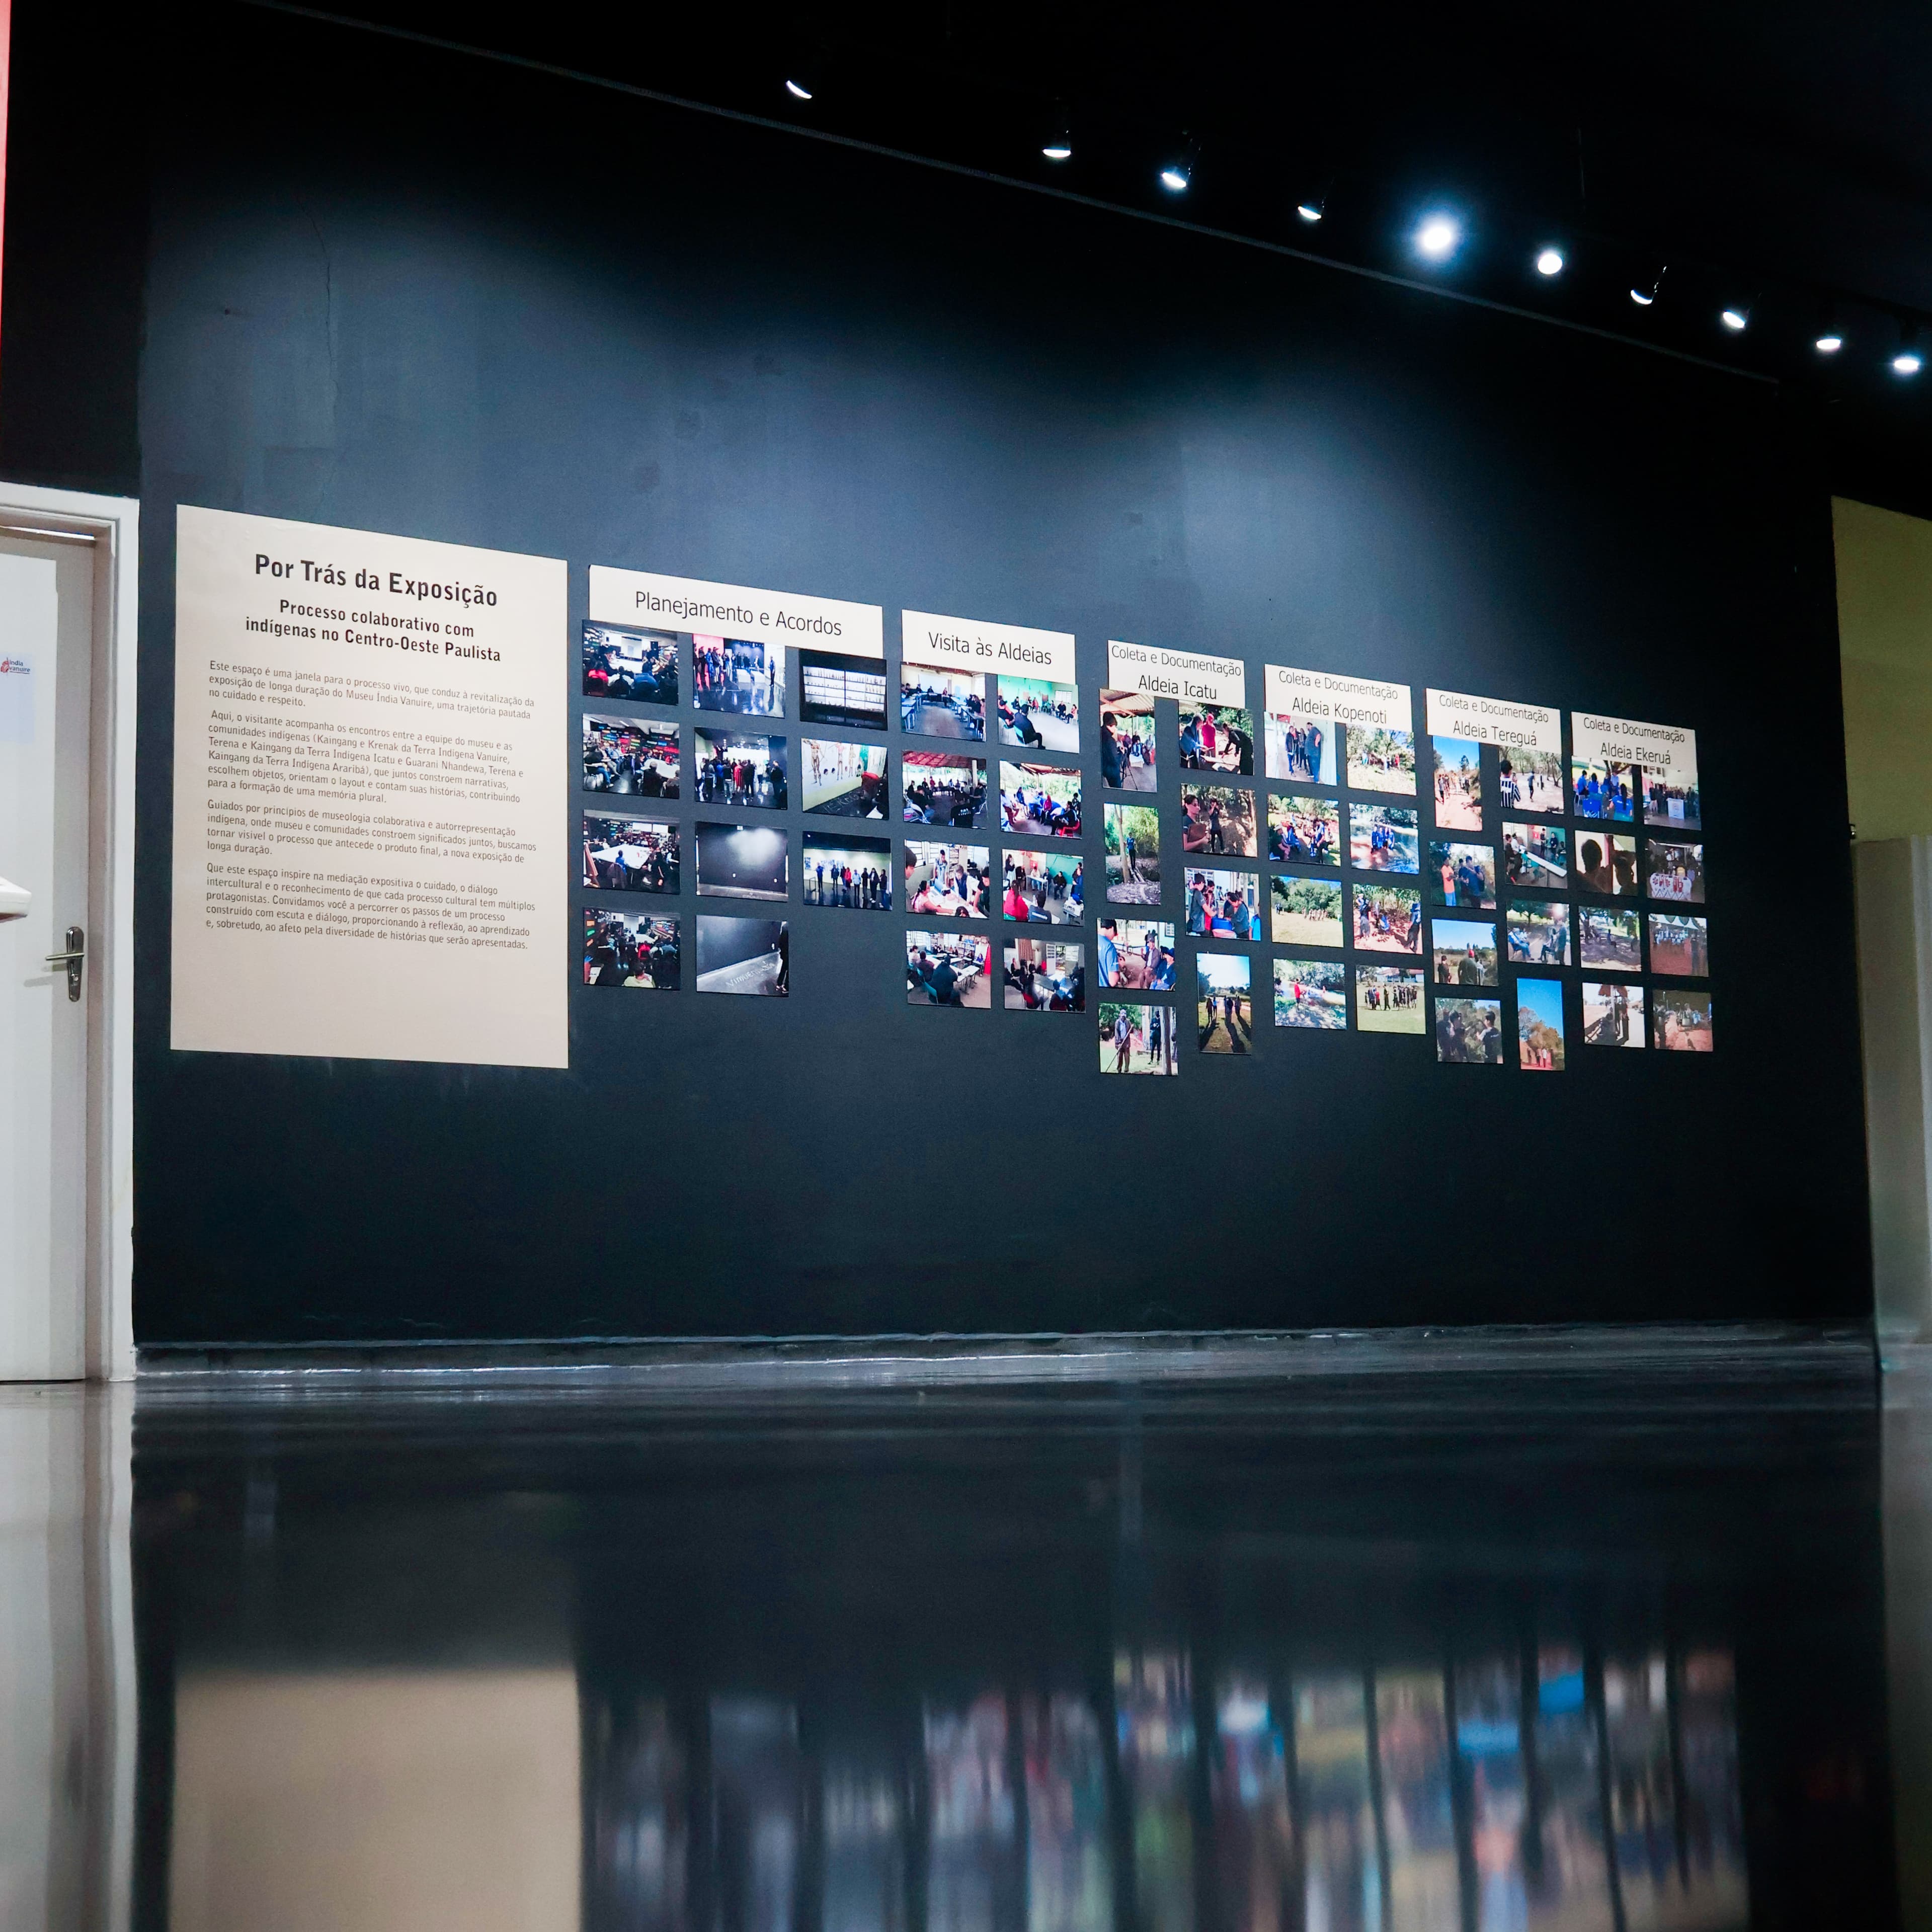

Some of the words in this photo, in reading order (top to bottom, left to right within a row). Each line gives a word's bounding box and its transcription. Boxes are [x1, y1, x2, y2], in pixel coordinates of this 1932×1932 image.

[256, 553, 294, 578] Por
[300, 559, 346, 586] Trás
[355, 569, 380, 591] da
[389, 572, 497, 608] Exposição
[280, 599, 346, 620] Processo
[351, 611, 439, 632] colaborativo
[445, 624, 473, 637] com
[636, 591, 753, 623] Planejamento
[760, 613, 769, 625] e
[776, 611, 841, 635] Acordos
[246, 616, 316, 638] indígenas
[322, 629, 339, 641] no
[345, 629, 439, 654] Centro-Oeste
[445, 641, 501, 662] Paulista
[929, 632, 969, 653] Visita
[976, 637, 992, 656] às
[998, 642, 1052, 665] Aldeias
[1112, 646, 1146, 662] Coleta
[1151, 654, 1157, 663] e
[1162, 653, 1241, 677] Documentação
[209, 676, 253, 688] exposição
[255, 679, 266, 689] de
[269, 680, 292, 692] longa
[295, 684, 330, 697] duração
[332, 688, 343, 697] do
[346, 689, 373, 701] Museu
[376, 691, 397, 703] Índia
[437, 702, 454, 710] uma
[457, 703, 496, 715] trajetória
[499, 709, 530, 719] pautada
[210, 660, 229, 671] Este
[232, 665, 262, 677] espaço
[265, 667, 270, 676] é
[273, 670, 292, 678] uma
[294, 670, 321, 682] janela
[324, 676, 343, 684] para
[354, 679, 390, 690] processo
[393, 682, 412, 694] vivo,
[414, 686, 429, 695] que
[432, 688, 460, 698] conduz
[470, 692, 522, 706] revitalização
[525, 698, 534, 706] da
[222, 690, 257, 701] cuidado
[267, 696, 305, 706] respeito.
[1138, 675, 1178, 695] Aldeia
[1184, 681, 1217, 700] Icatu
[1279, 671, 1311, 686] Coleta
[1315, 679, 1320, 687] e
[1325, 678, 1397, 700] Documentação
[1293, 697, 1329, 715] Aldeia
[1334, 703, 1386, 725] Kopenoti
[1439, 695, 1468, 709] Coleta
[1472, 703, 1477, 711] e
[1481, 701, 1548, 723] Documentação
[211, 709, 234, 722] Aqui,
[245, 713, 283, 726] visitante
[285, 719, 334, 731] acompanha
[349, 727, 390, 738] encontros
[392, 731, 415, 740] entre
[425, 735, 452, 745] equipe
[455, 737, 465, 746] do
[467, 740, 494, 748] museu
[1453, 720, 1487, 738] Aldeia
[1491, 726, 1536, 748] Tereguá
[1584, 717, 1611, 732] Coleta
[1614, 725, 1619, 733] e
[1622, 723, 1684, 744] Documentação
[1600, 743, 1632, 760] Aldeia
[1636, 747, 1670, 765] Ekeruá
[207, 779, 228, 788] para
[239, 779, 280, 794] formação
[283, 784, 294, 794] de
[296, 787, 315, 796] uma
[318, 789, 356, 800] memória
[359, 792, 386, 803] plural.
[208, 765, 249, 776] escolhem
[252, 768, 286, 782] objetos,
[288, 772, 328, 784] orientam
[339, 776, 365, 788] layout
[375, 782, 407, 791] contam
[409, 785, 427, 793] suas
[430, 785, 467, 799] histórias,
[469, 791, 520, 802] contribuindo
[207, 799, 243, 812] Guiados
[246, 805, 261, 814] por
[308, 809, 319, 818] de
[322, 812, 370, 824] museologia
[373, 815, 425, 828] colaborativa
[435, 822, 515, 837] autorrepresentação
[207, 840, 231, 852] longa
[234, 842, 272, 856] duração.
[207, 862, 224, 873] Que
[226, 866, 246, 874] este
[248, 868, 278, 879] espaço
[281, 868, 310, 880] inspire
[327, 873, 368, 886] mediação
[370, 877, 413, 888] expositiva
[424, 881, 458, 893] cuidado,
[467, 883, 498, 896] diálogo
[207, 876, 262, 890] intercultural
[281, 883, 351, 896] reconhecimento
[353, 888, 364, 898] de
[366, 891, 382, 900] que
[384, 891, 404, 900] cada
[407, 894, 443, 904] processo
[445, 896, 476, 906] cultural
[479, 898, 495, 908] tem
[498, 900, 535, 911] múltiplos
[206, 892, 270, 904] protagonistas.
[272, 895, 325, 908] Convidamos
[327, 900, 347, 909] você
[357, 903, 398, 913] percorrer
[413, 907, 440, 917] passos
[442, 908, 452, 918] de
[469, 912, 505, 921] processo
[206, 920, 214, 929] e,
[216, 918, 263, 932] sobretudo,
[278, 922, 301, 933] afeto
[304, 925, 323, 935] pela
[326, 926, 374, 938] diversidade
[377, 929, 387, 939] de
[390, 930, 426, 942] histórias
[429, 935, 444, 944] que
[446, 936, 469, 945] serão
[471, 938, 527, 949] apresentadas.
